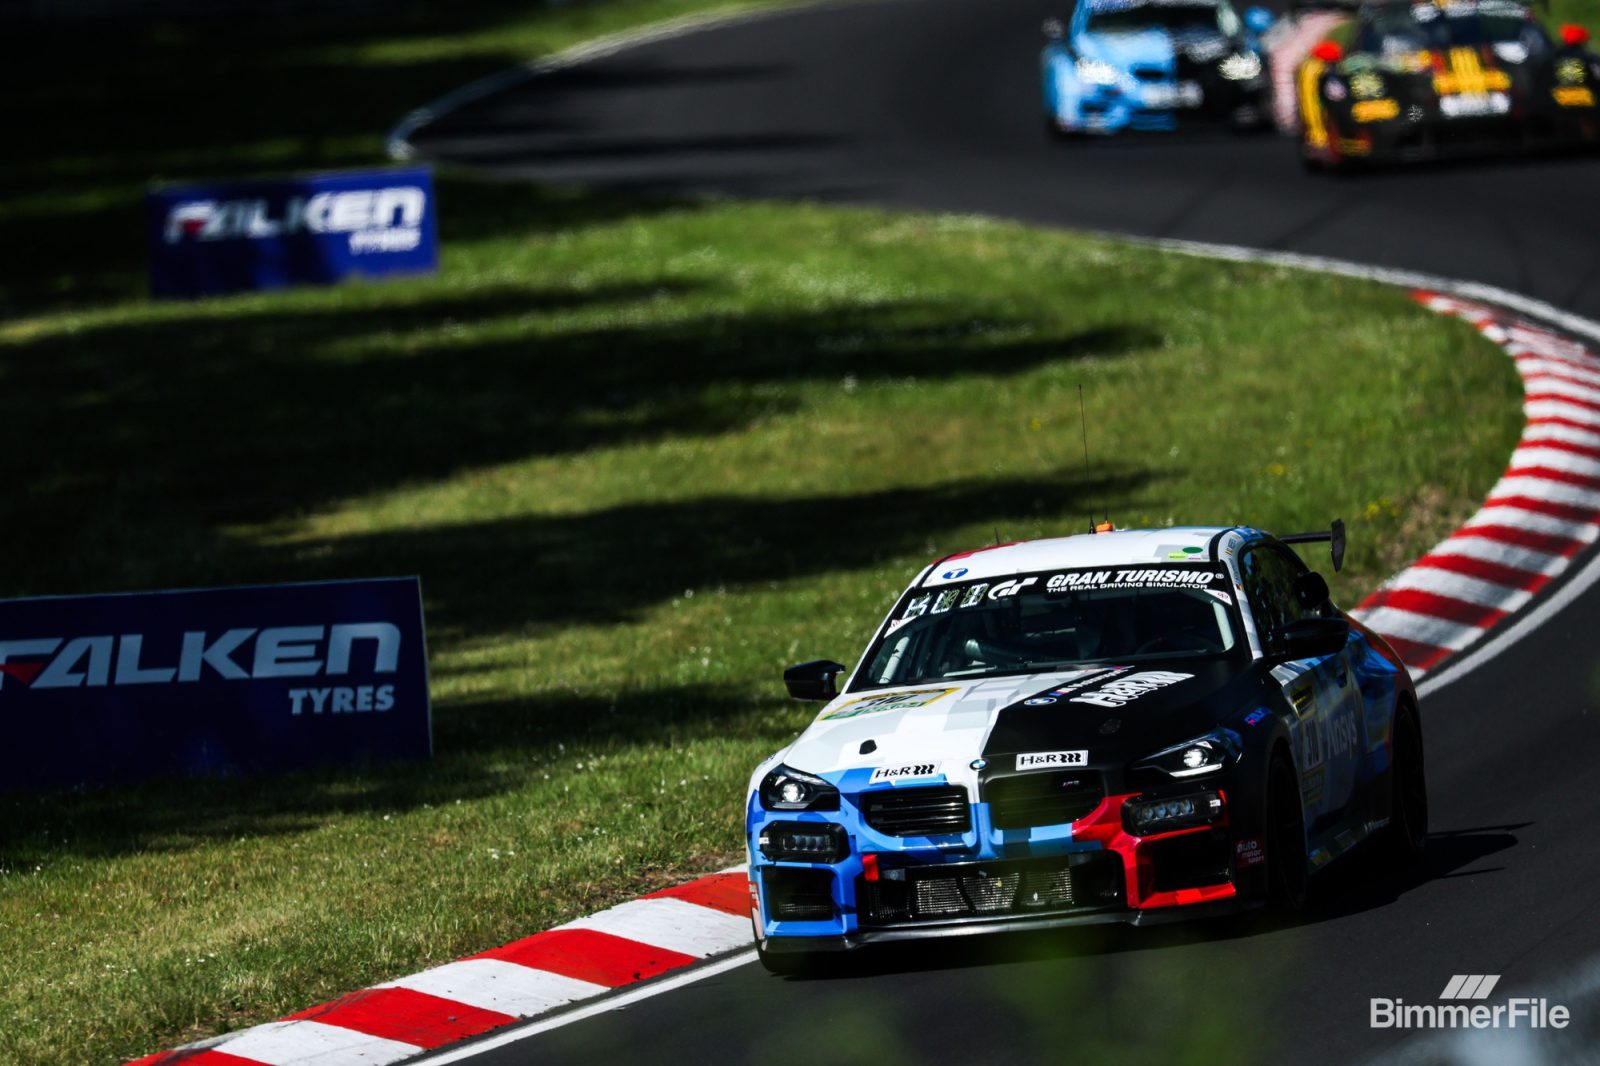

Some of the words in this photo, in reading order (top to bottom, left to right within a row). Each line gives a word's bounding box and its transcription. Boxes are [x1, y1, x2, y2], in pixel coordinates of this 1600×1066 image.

[1046, 570, 1111, 588] GRAN
[1115, 569, 1216, 584] TURISMO
[1046, 586, 1068, 594] THE
[1069, 583, 1098, 591] REAL
[1100, 581, 1144, 589] DRIVING
[1145, 581, 1208, 590] SIMULATOR
[0, 621, 402, 691] FALKEN
[289, 684, 395, 716] TYRES
[1021, 754, 1057, 765] H&R
[875, 767, 911, 779] H&R
